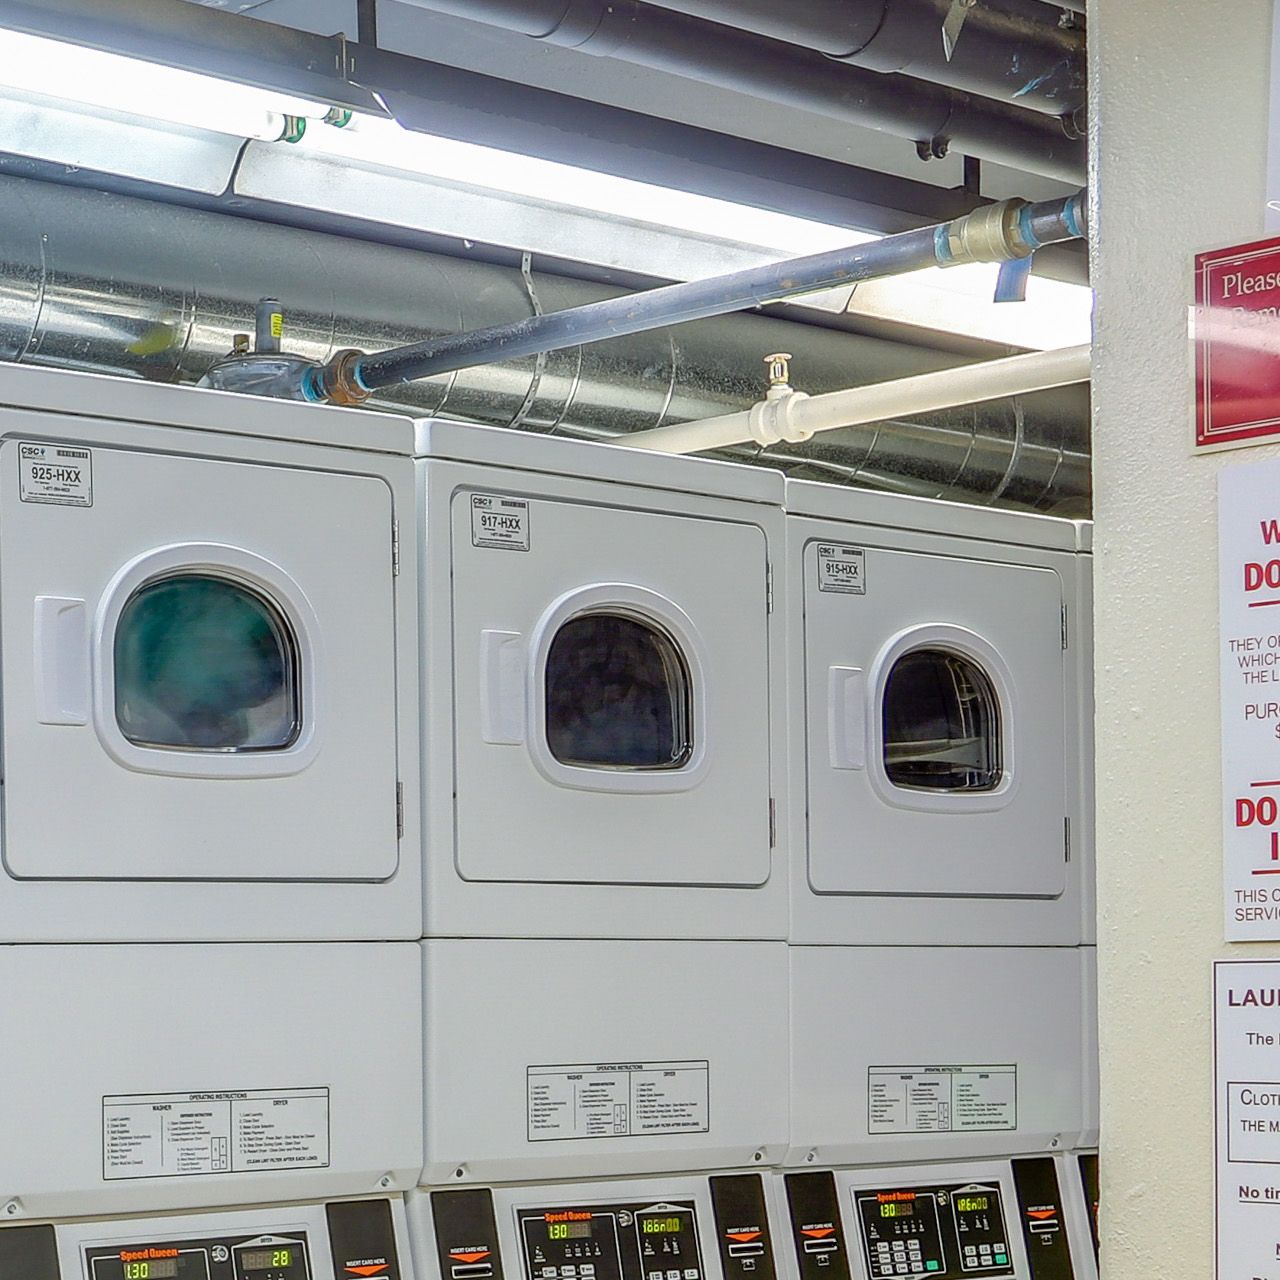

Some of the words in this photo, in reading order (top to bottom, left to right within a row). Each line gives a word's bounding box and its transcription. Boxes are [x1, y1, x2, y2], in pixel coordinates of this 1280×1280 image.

[21, 447, 39, 455] CSC
[32, 467, 81, 483] 925-HXX
[481, 516, 521, 530] 917-HXX
[1229, 637, 1263, 653] THEY
[1242, 670, 1268, 684] THE
[1245, 702, 1280, 720] PUR
[1236, 796, 1277, 827] DO
[1234, 889, 1268, 904] THIS
[1235, 907, 1280, 921] SERVI
[1229, 989, 1280, 1006] LAU
[1245, 1032, 1274, 1045] The
[1241, 1120, 1265, 1132] THE
[1239, 1186, 1259, 1199] No
[545, 1212, 568, 1222] Speed
[568, 1211, 592, 1219] Queen
[120, 1250, 149, 1261] Speed
[150, 1248, 178, 1258] Queen
[272, 1251, 288, 1266] 28
